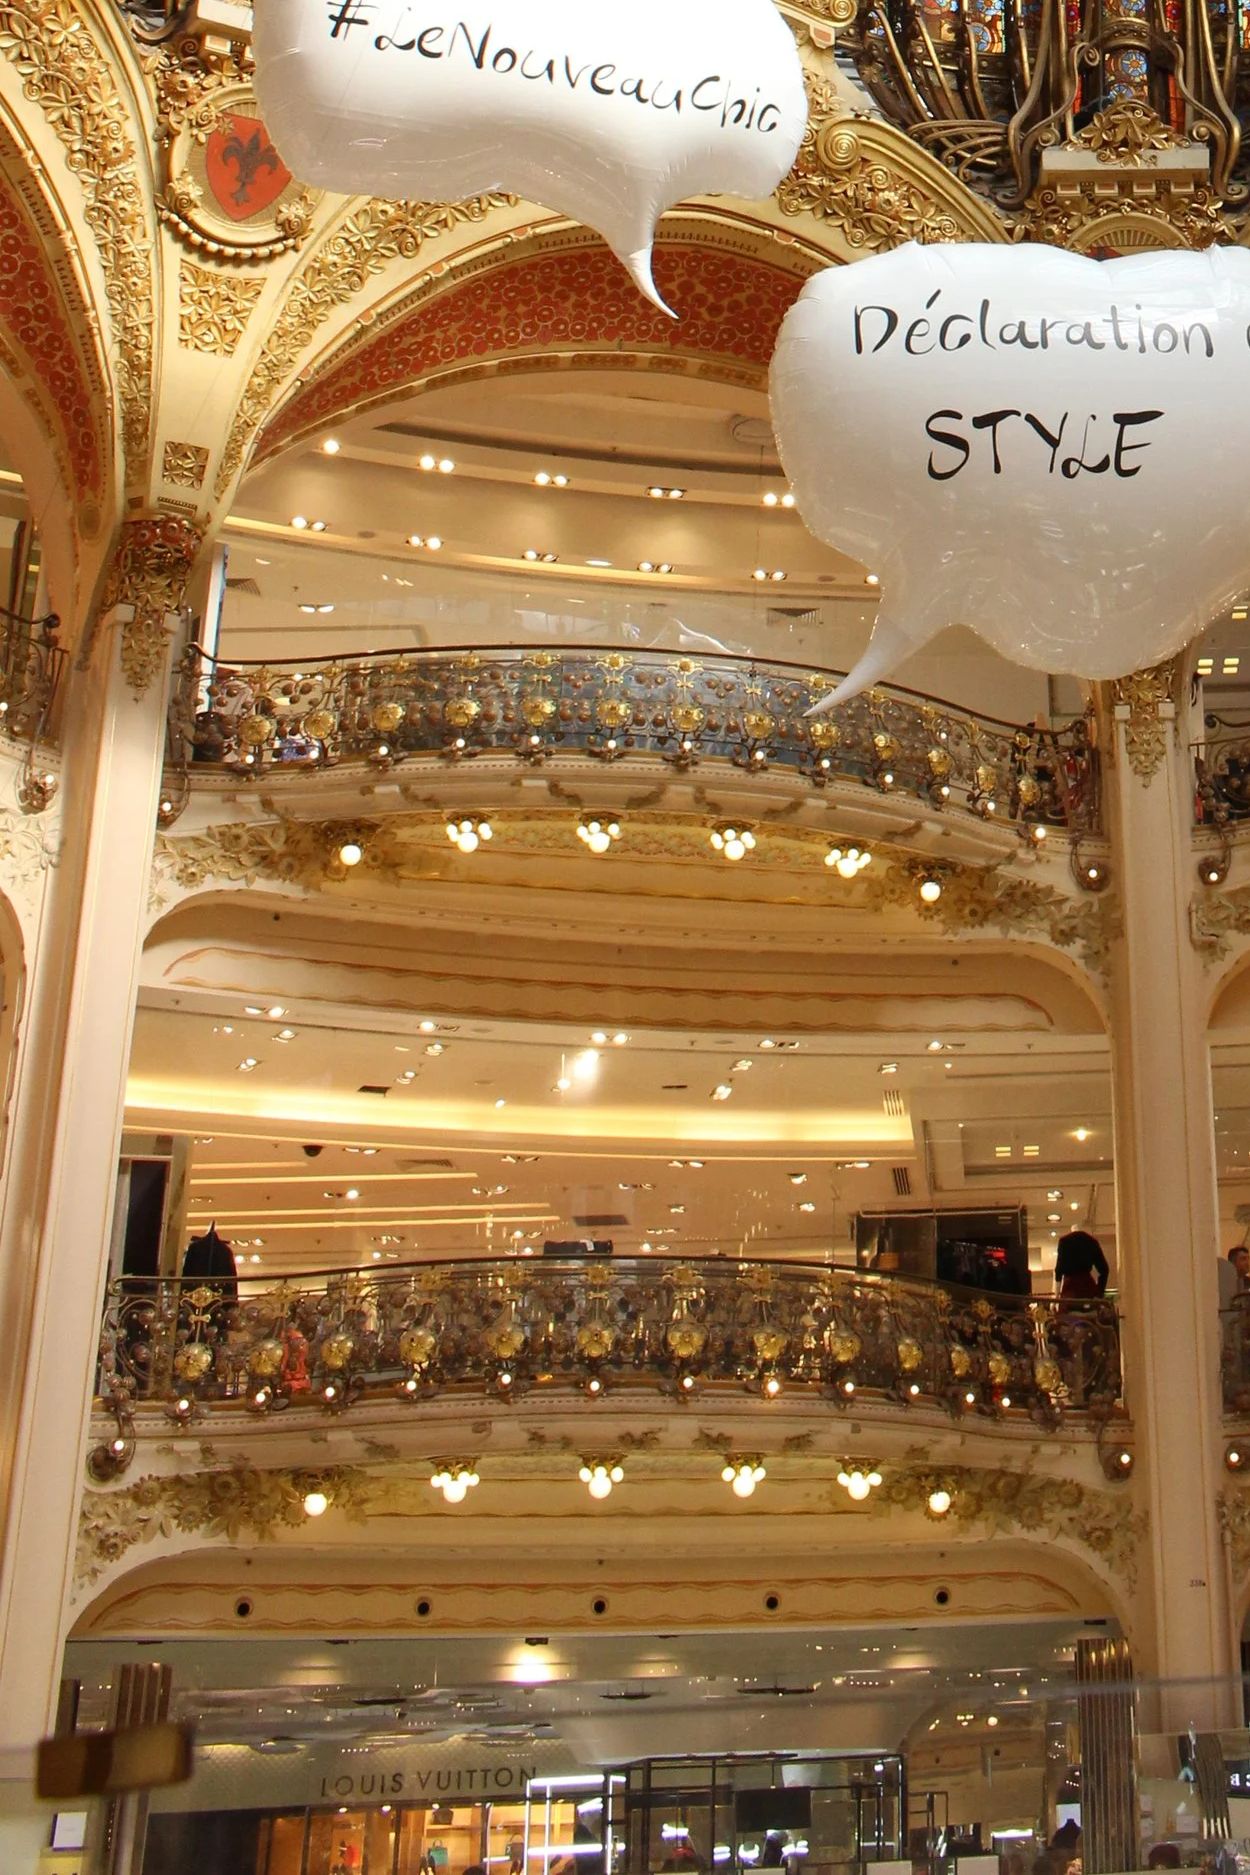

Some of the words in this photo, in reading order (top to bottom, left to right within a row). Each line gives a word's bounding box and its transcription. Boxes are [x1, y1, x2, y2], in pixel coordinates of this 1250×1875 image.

[853, 289, 1214, 357] Déclaration
[925, 409, 1165, 480] STYLE
[321, 1773, 403, 1797] LOUIS
[417, 1766, 537, 1790] VUITTON
